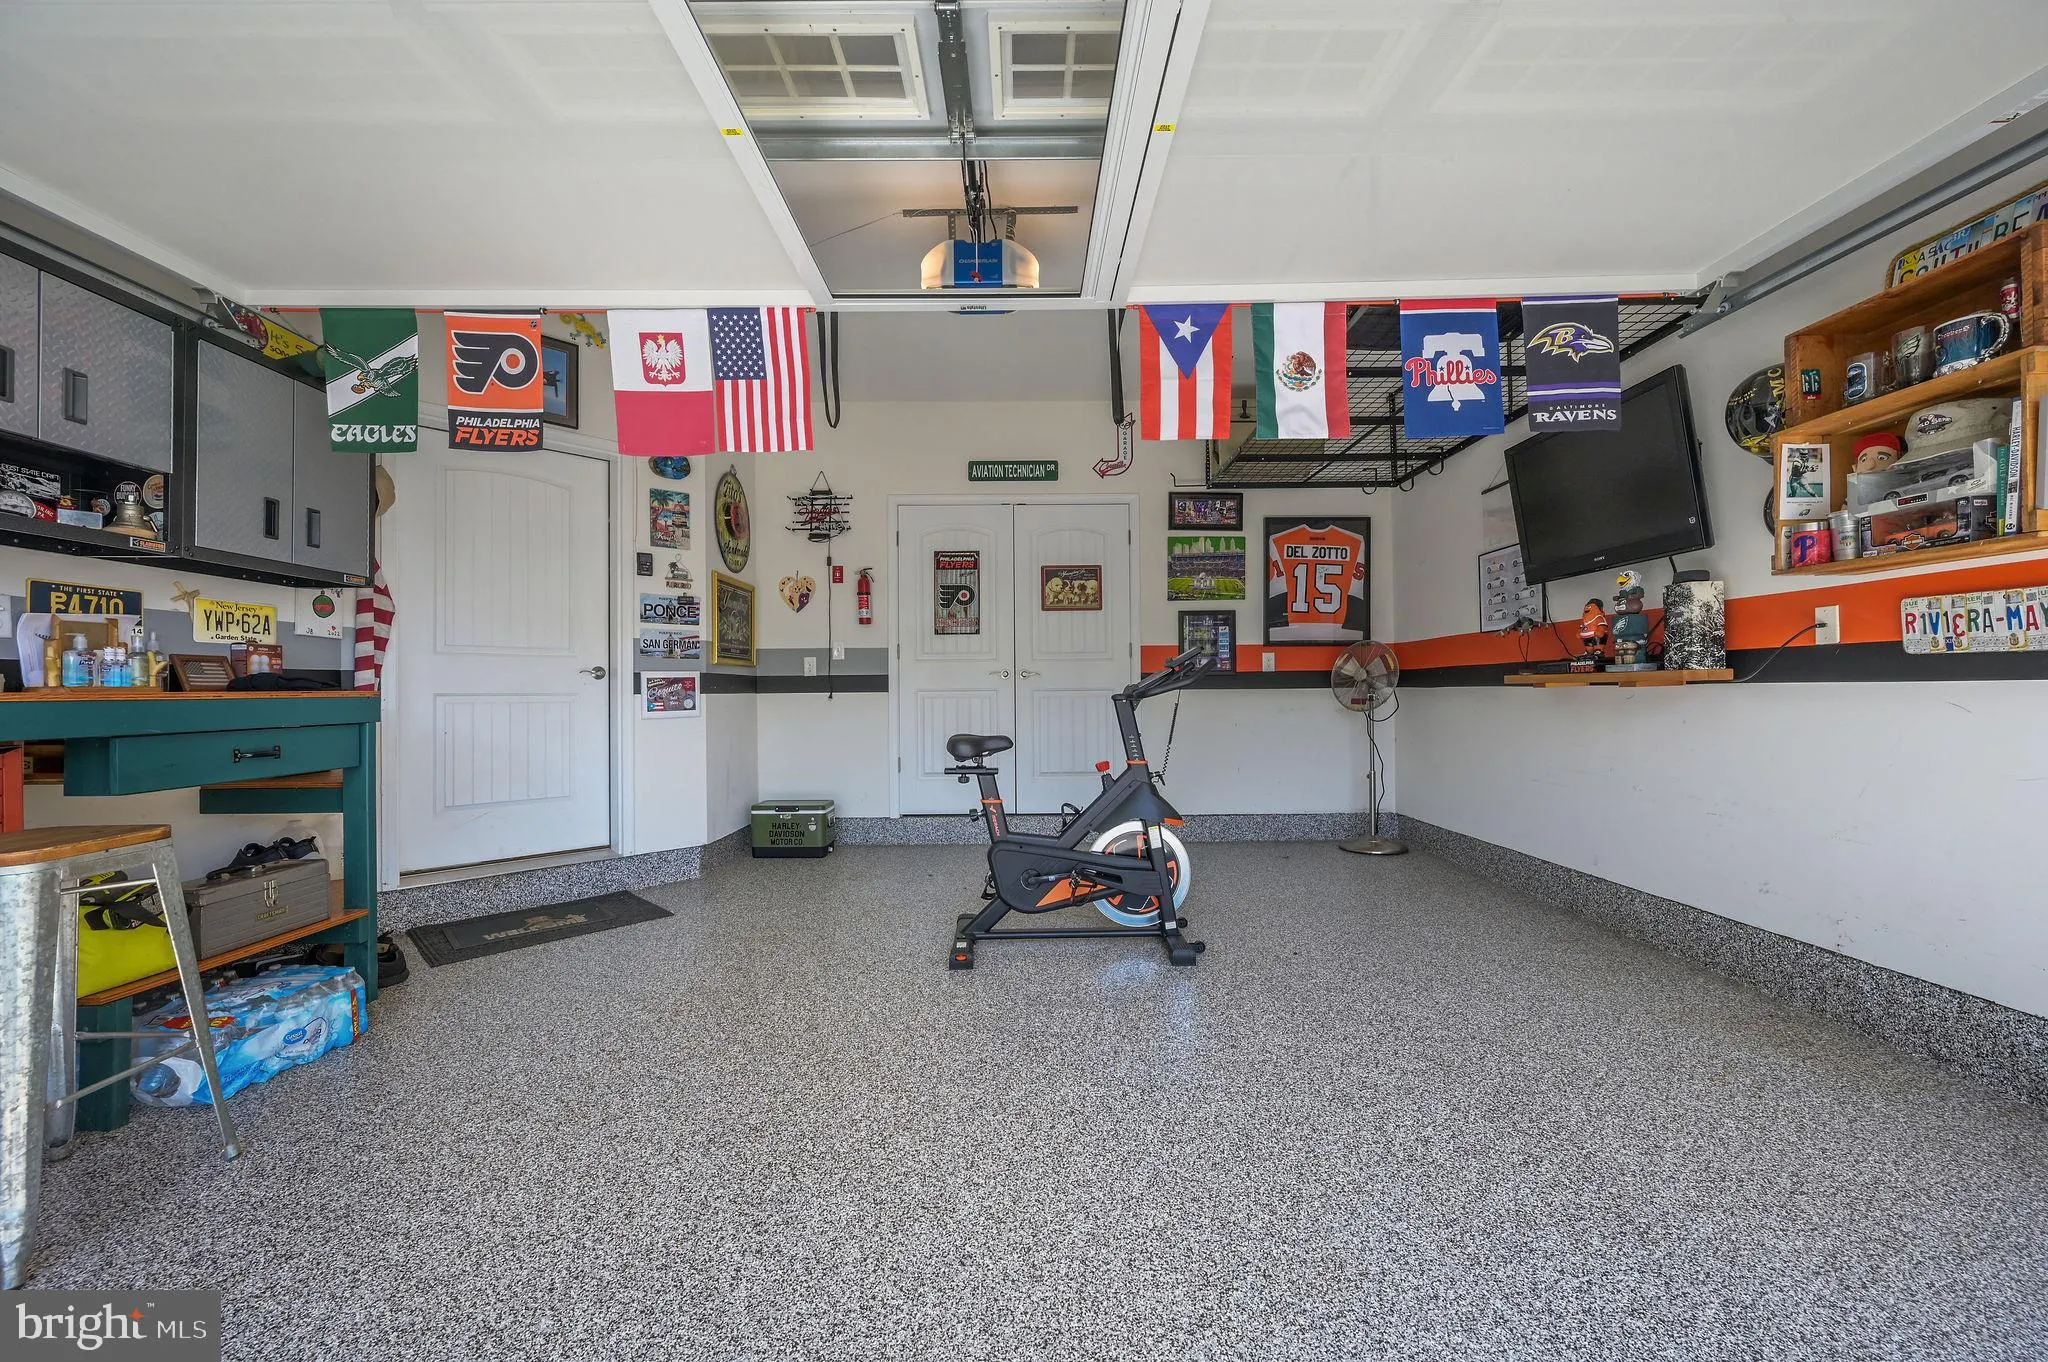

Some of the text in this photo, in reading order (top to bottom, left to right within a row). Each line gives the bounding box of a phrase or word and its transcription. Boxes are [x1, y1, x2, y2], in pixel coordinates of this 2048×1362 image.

[1404, 357, 1497, 388] Phillies
[1549, 403, 1606, 411] BALTIMORE
[455, 415, 540, 428] PHILADELPHIA
[1532, 409, 1617, 423] RAVENS
[331, 423, 417, 443] EAGLES
[454, 426, 540, 446] FLYERS
[971, 464, 1004, 478] AVIATION
[1004, 464, 1045, 478] TECHNICIAN
[1286, 545, 1348, 559] DEL ZOTTO
[1291, 563, 1344, 614] 15
[215, 600, 258, 614] New Jersey
[643, 603, 697, 619] PONCE
[215, 633, 239, 642] Garden
[642, 638, 661, 649] SAN
[768, 830, 805, 838] DAVIDSON
[770, 838, 793, 846] MOTOR
[285, 1030, 303, 1042] Great
